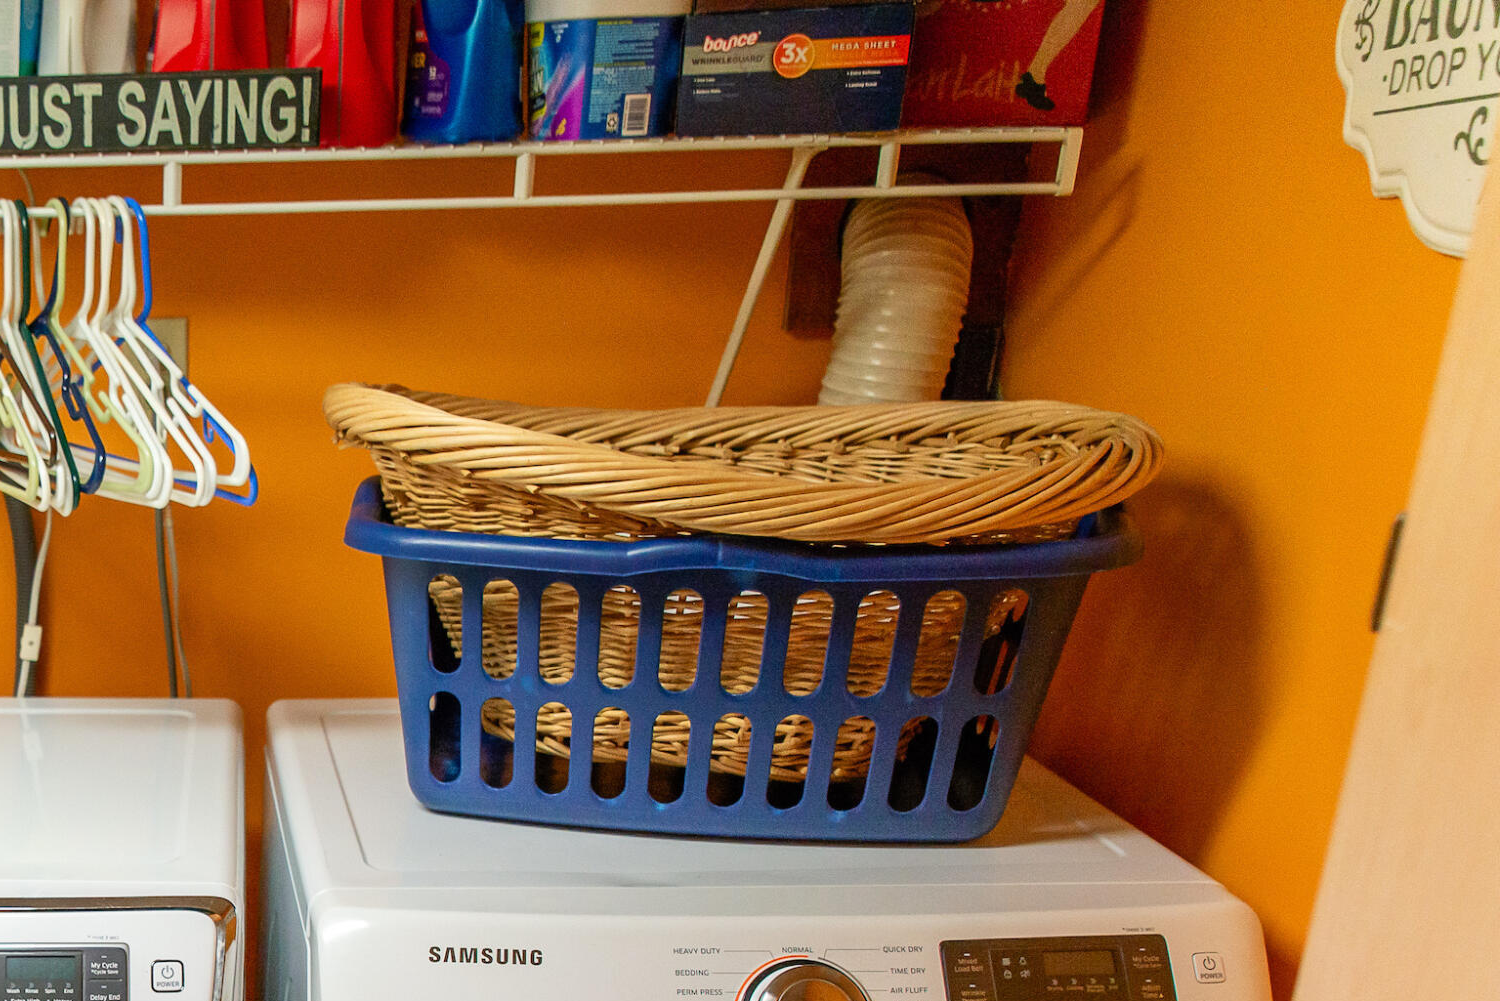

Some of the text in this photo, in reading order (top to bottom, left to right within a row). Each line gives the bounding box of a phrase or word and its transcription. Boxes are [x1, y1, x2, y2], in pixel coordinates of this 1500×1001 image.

[703, 31, 759, 53] bounce
[863, 40, 897, 50] SHEET
[1388, 46, 1467, 96] DROP
[116, 76, 313, 148] SAYING!
[673, 947, 721, 955] HEAVY DUTY
[882, 945, 924, 953] QUICK DRY
[428, 946, 543, 966] SAMSUNG
[675, 969, 710, 977] BEDDING
[890, 967, 909, 975] TIME
[676, 988, 723, 996] PERM PRESS
[890, 986, 928, 994] AIR FLUFF
